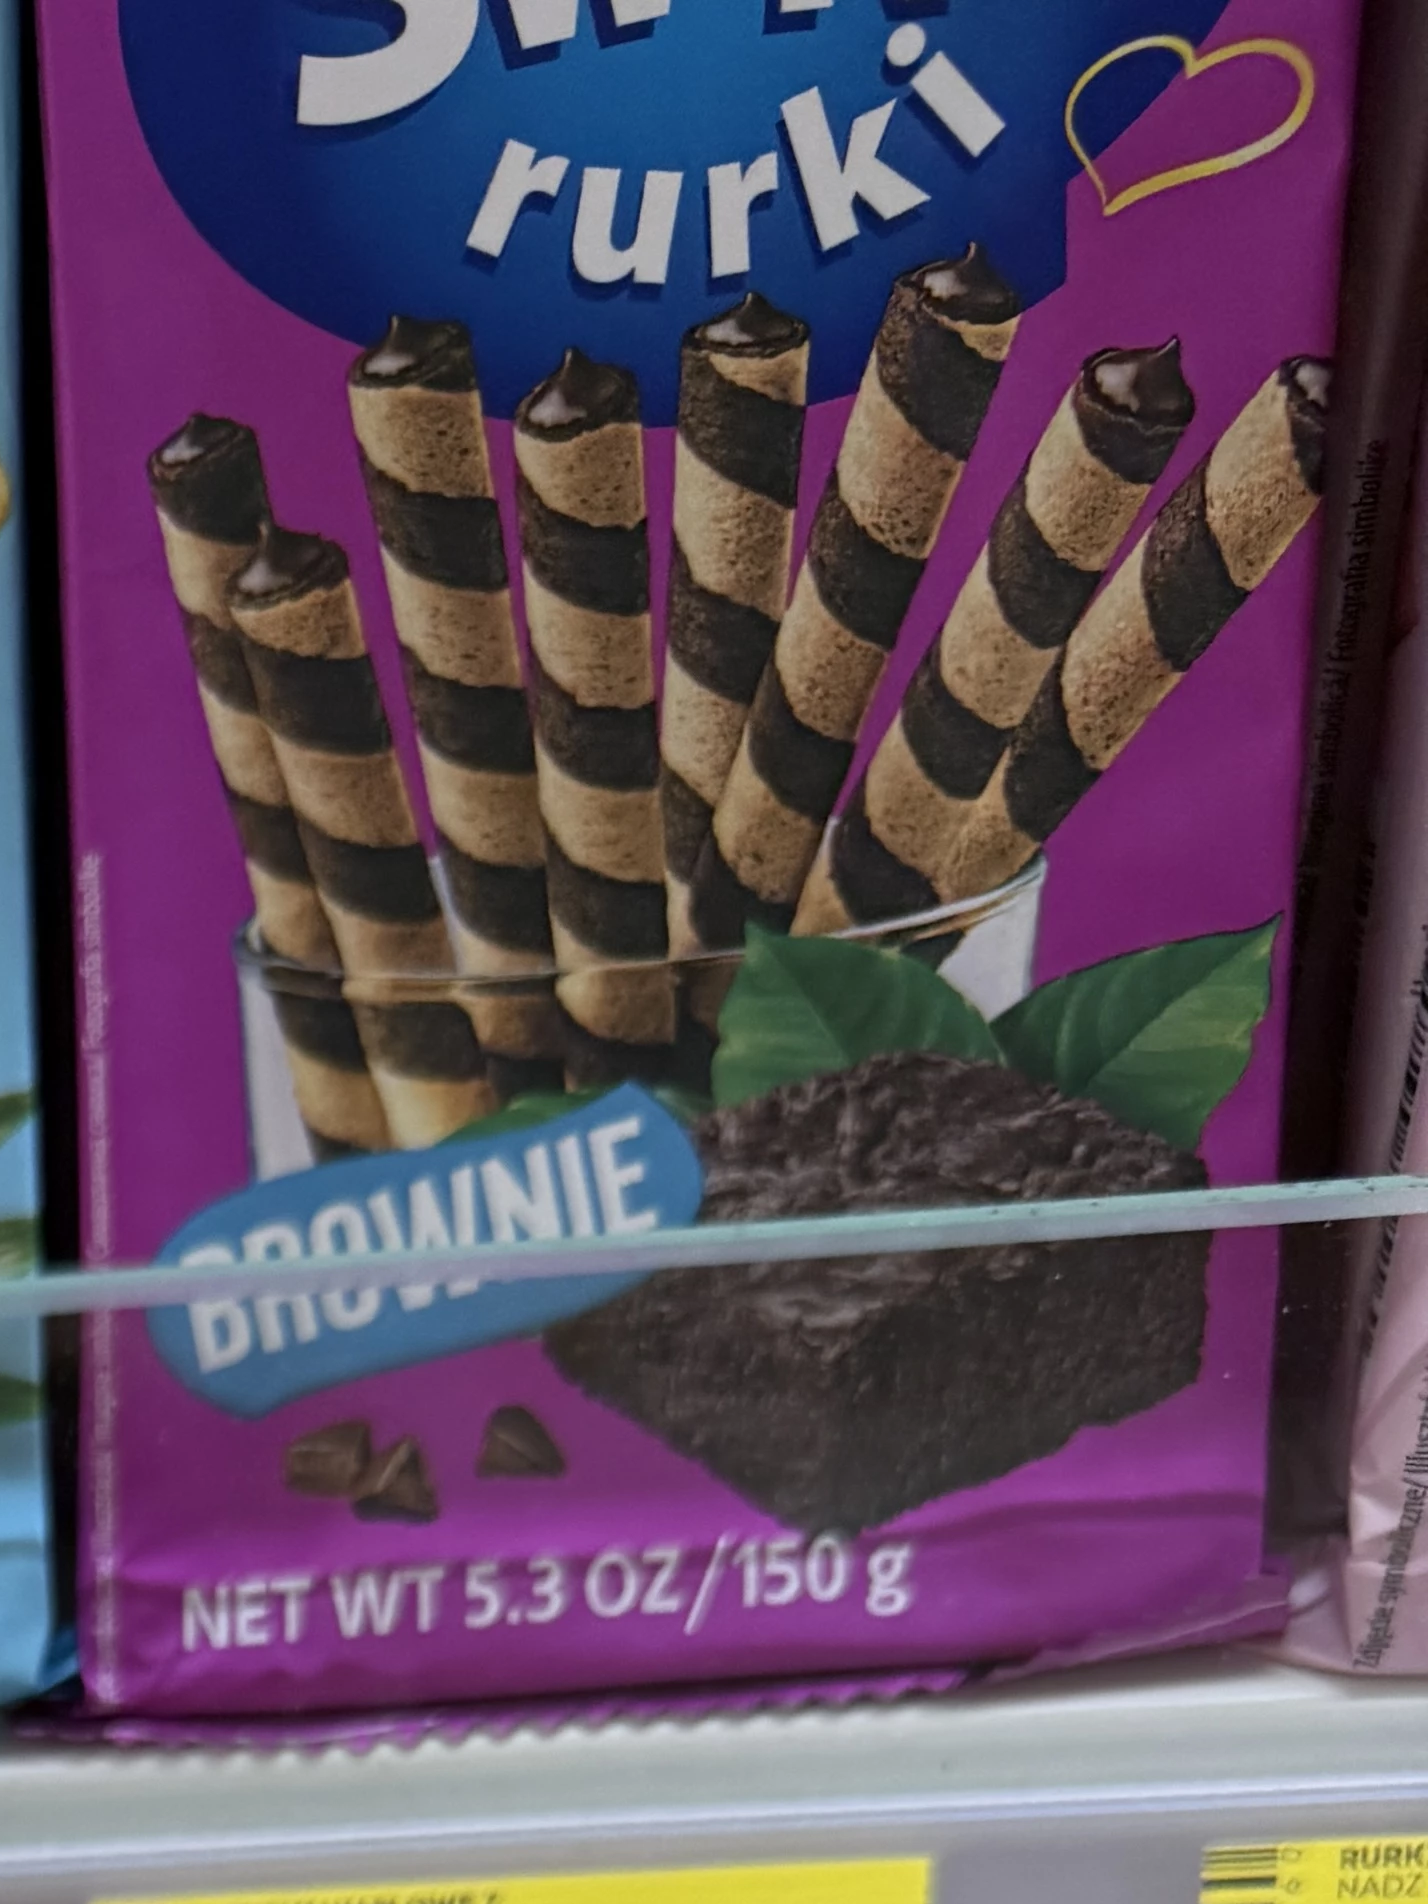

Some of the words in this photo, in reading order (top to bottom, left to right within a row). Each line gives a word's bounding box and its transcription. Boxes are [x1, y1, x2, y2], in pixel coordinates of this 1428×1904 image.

[466, 24, 1006, 285] rurki
[177, 1115, 658, 1374] BROWNIE
[181, 1577, 314, 1651] NET
[332, 1565, 446, 1637] WT
[464, 1559, 565, 1630] 5.3
[868, 1540, 914, 1616] g
